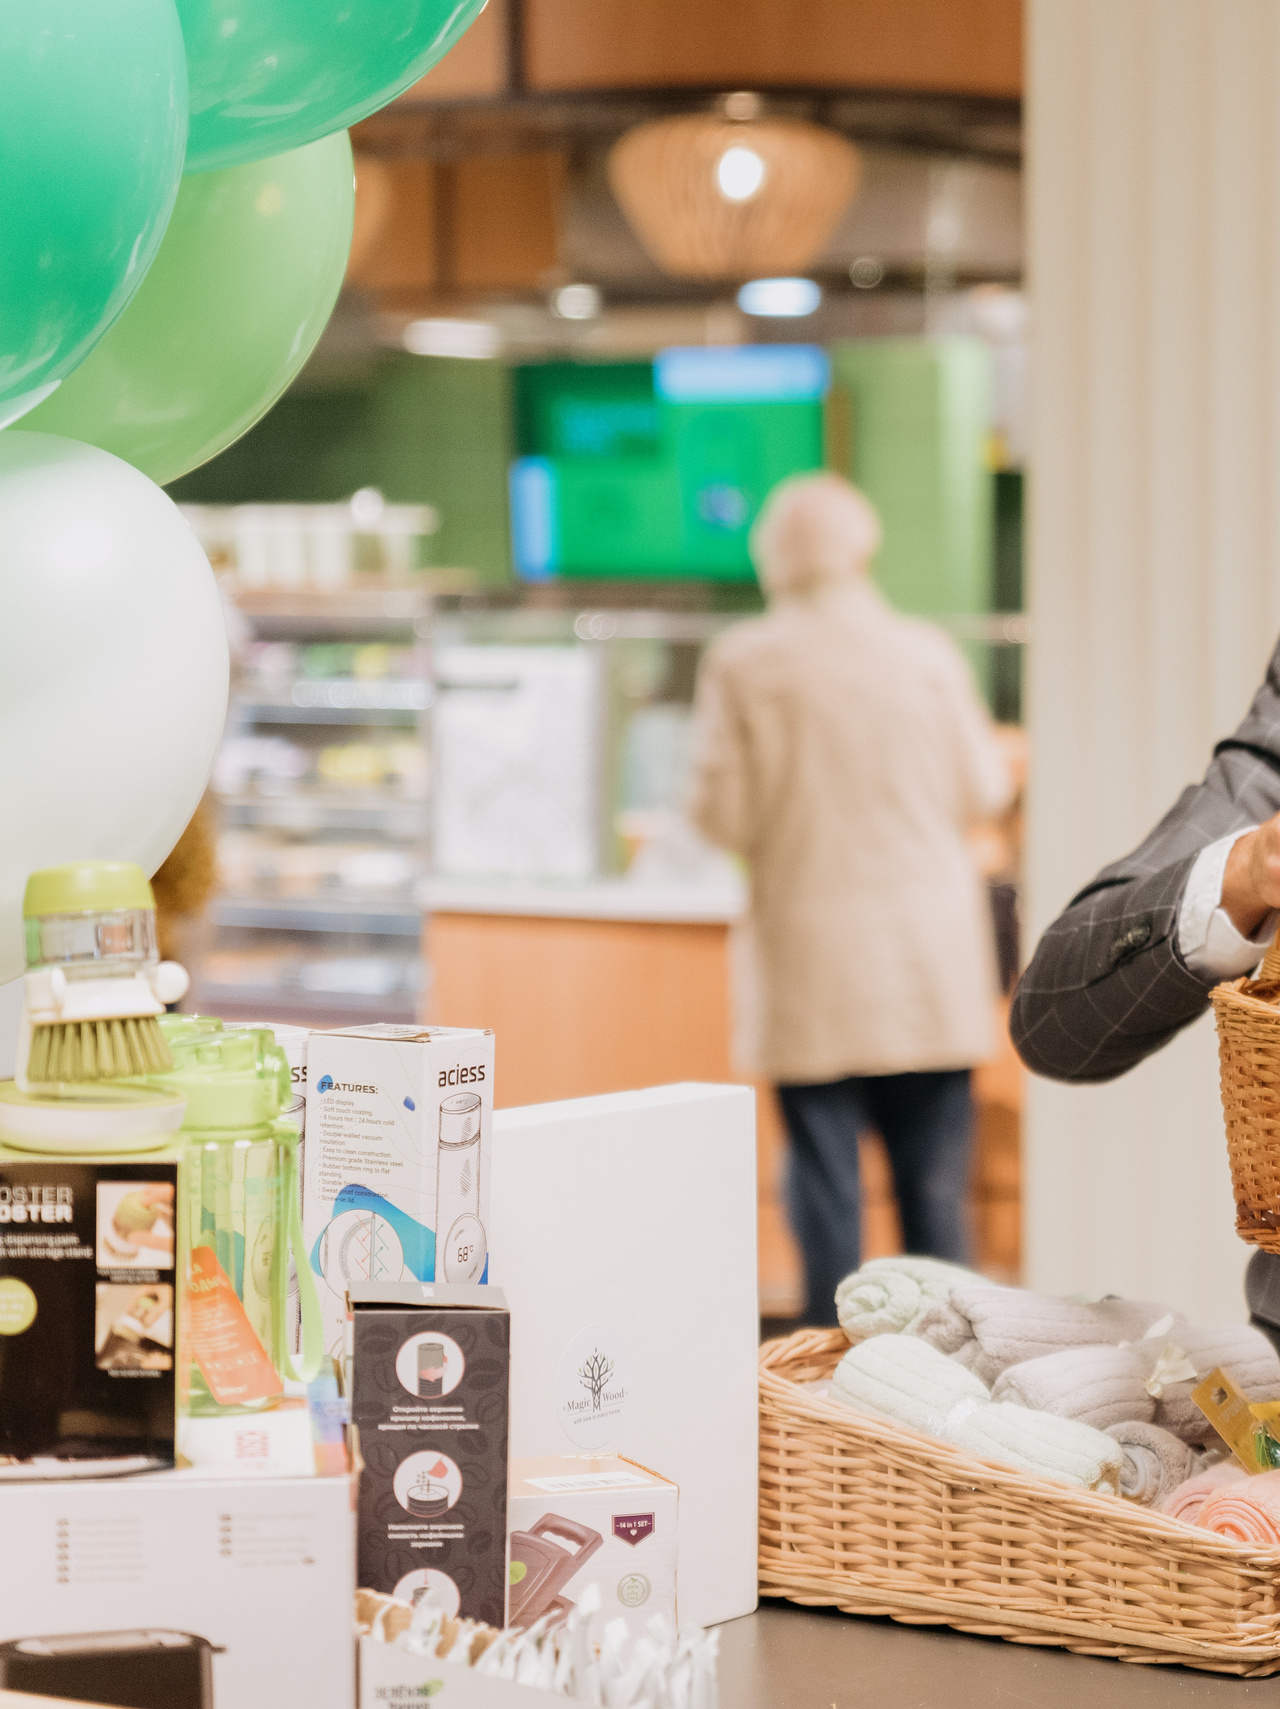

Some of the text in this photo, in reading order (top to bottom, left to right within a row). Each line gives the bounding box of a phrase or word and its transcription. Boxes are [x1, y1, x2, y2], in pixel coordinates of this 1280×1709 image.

[438, 1064, 486, 1088] aciess
[320, 1081, 379, 1094] FEATURES:
[322, 1146, 335, 1154] Easy
[358, 1150, 392, 1158] construction.
[348, 1157, 363, 1165] grade
[364, 1158, 389, 1166] Stainless
[362, 1166, 373, 1174] ring
[567, 1387, 625, 1412] Magic Wood
